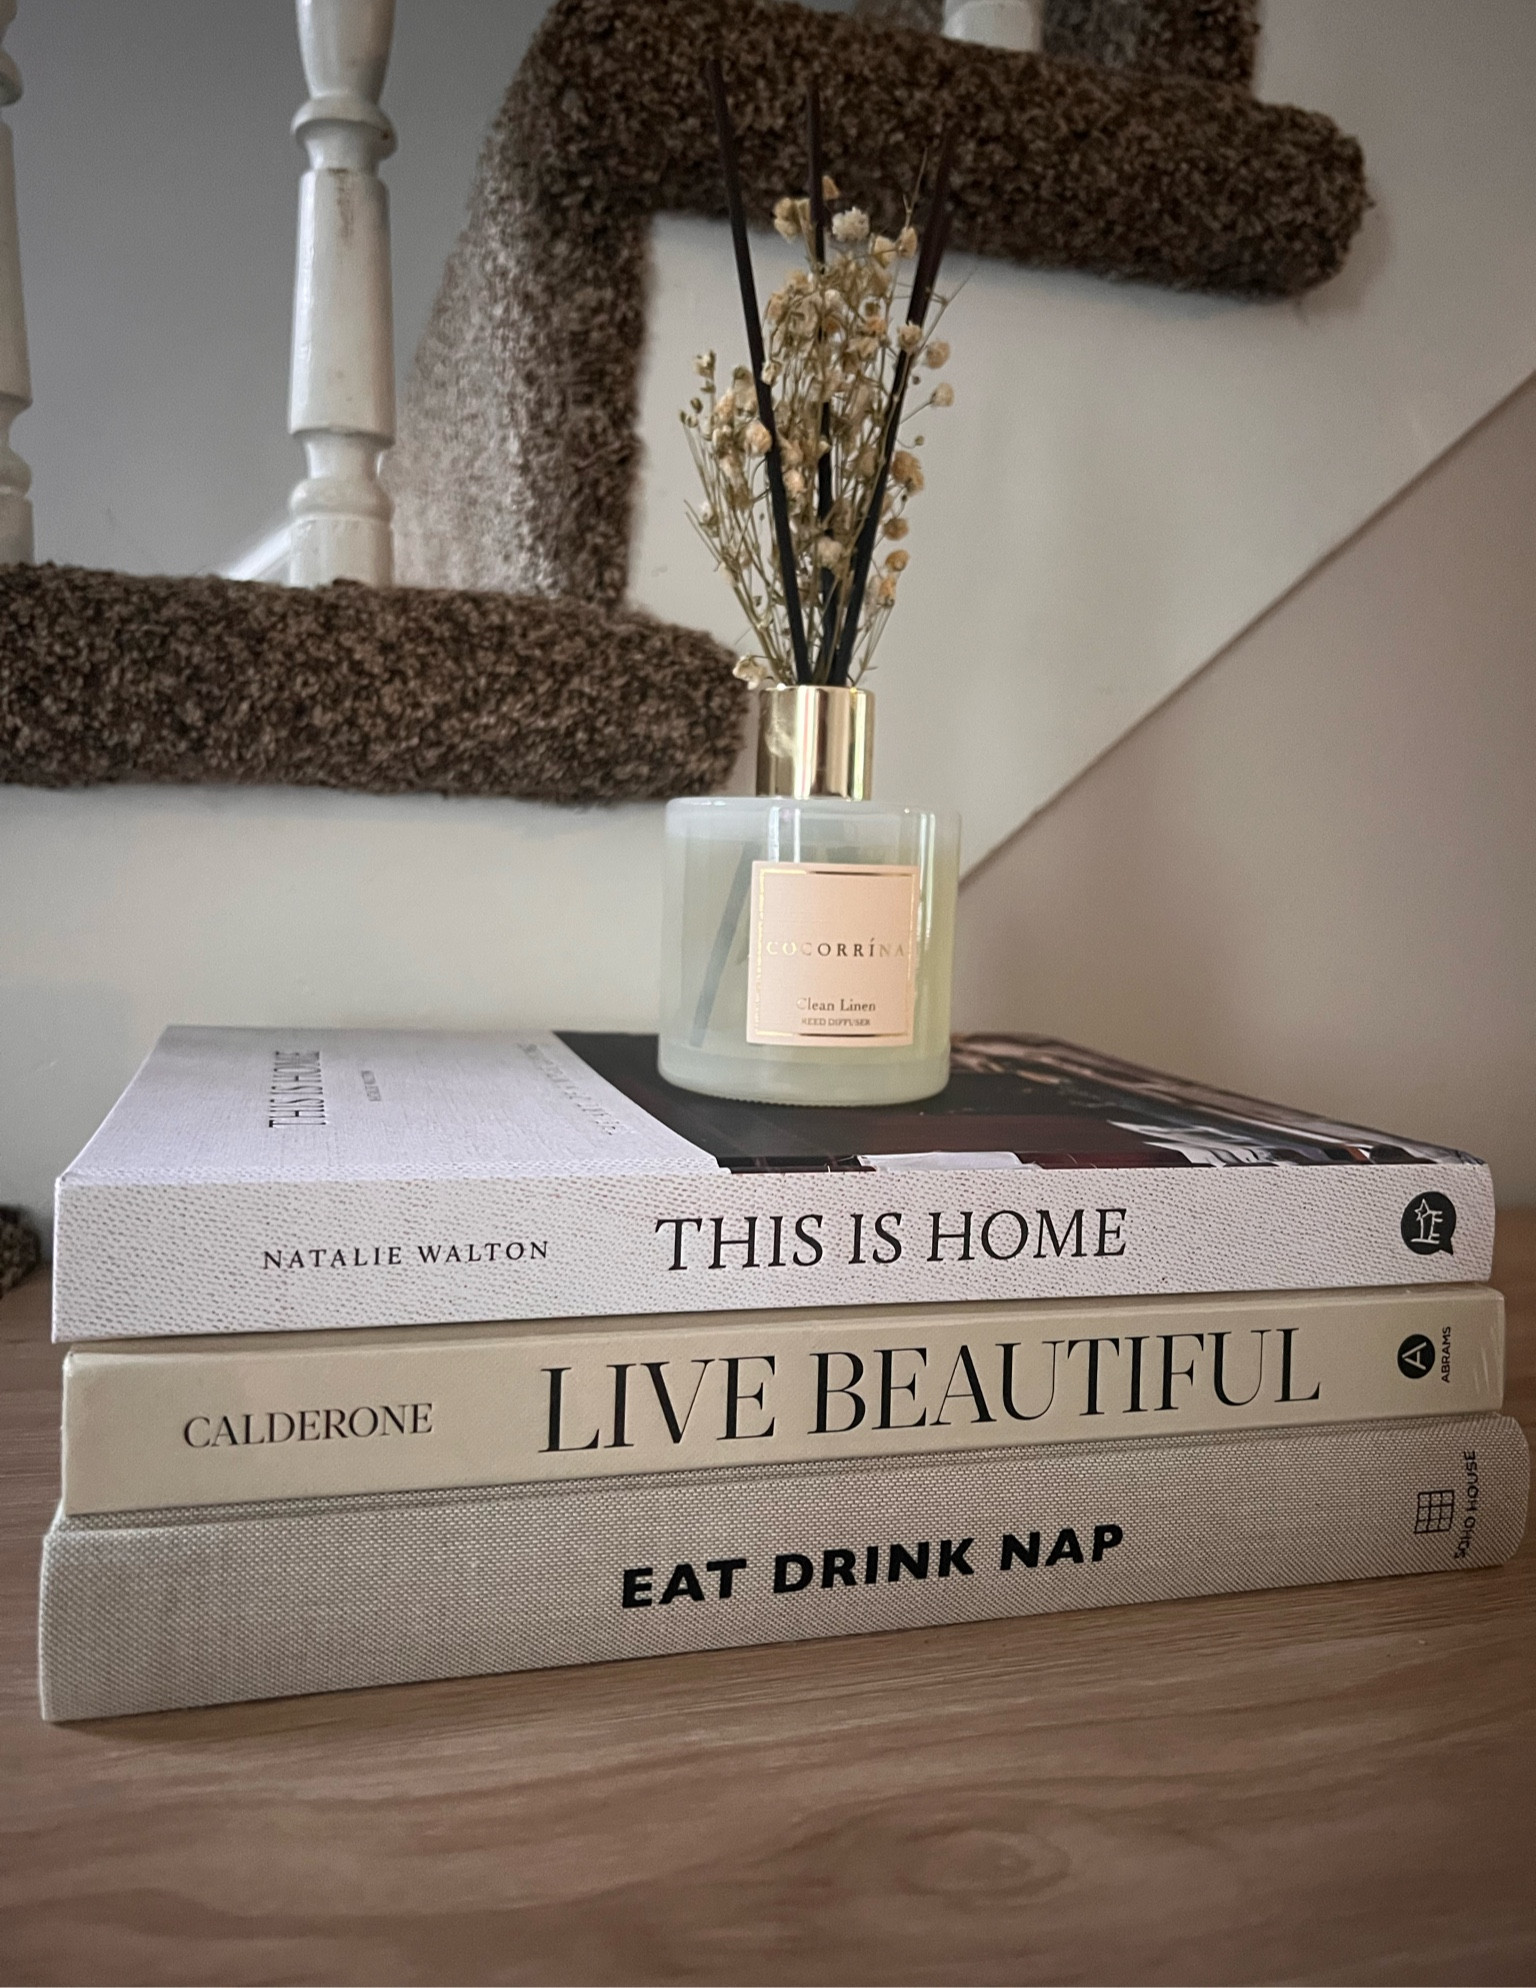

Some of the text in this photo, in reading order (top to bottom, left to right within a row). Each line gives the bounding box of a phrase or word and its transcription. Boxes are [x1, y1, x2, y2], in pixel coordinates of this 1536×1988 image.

[766, 937, 905, 957] COCORRÍNA
[797, 997, 876, 1012] Clean Linen
[801, 1017, 871, 1026] REED DIFFUSER
[270, 1086, 323, 1095] IS
[268, 1098, 326, 1128] THIS
[263, 1241, 549, 1270] NATALIE WALTON
[655, 1208, 1128, 1271] THIS IS HOME
[1441, 1326, 1451, 1384] ABRAMS
[538, 1328, 1322, 1454] LIVE BEAUTIFUL
[183, 1403, 434, 1449] CALDERONE
[1454, 1450, 1479, 1559] SOHO HOUSE
[621, 1524, 1124, 1608] EAT DRINK NAP
